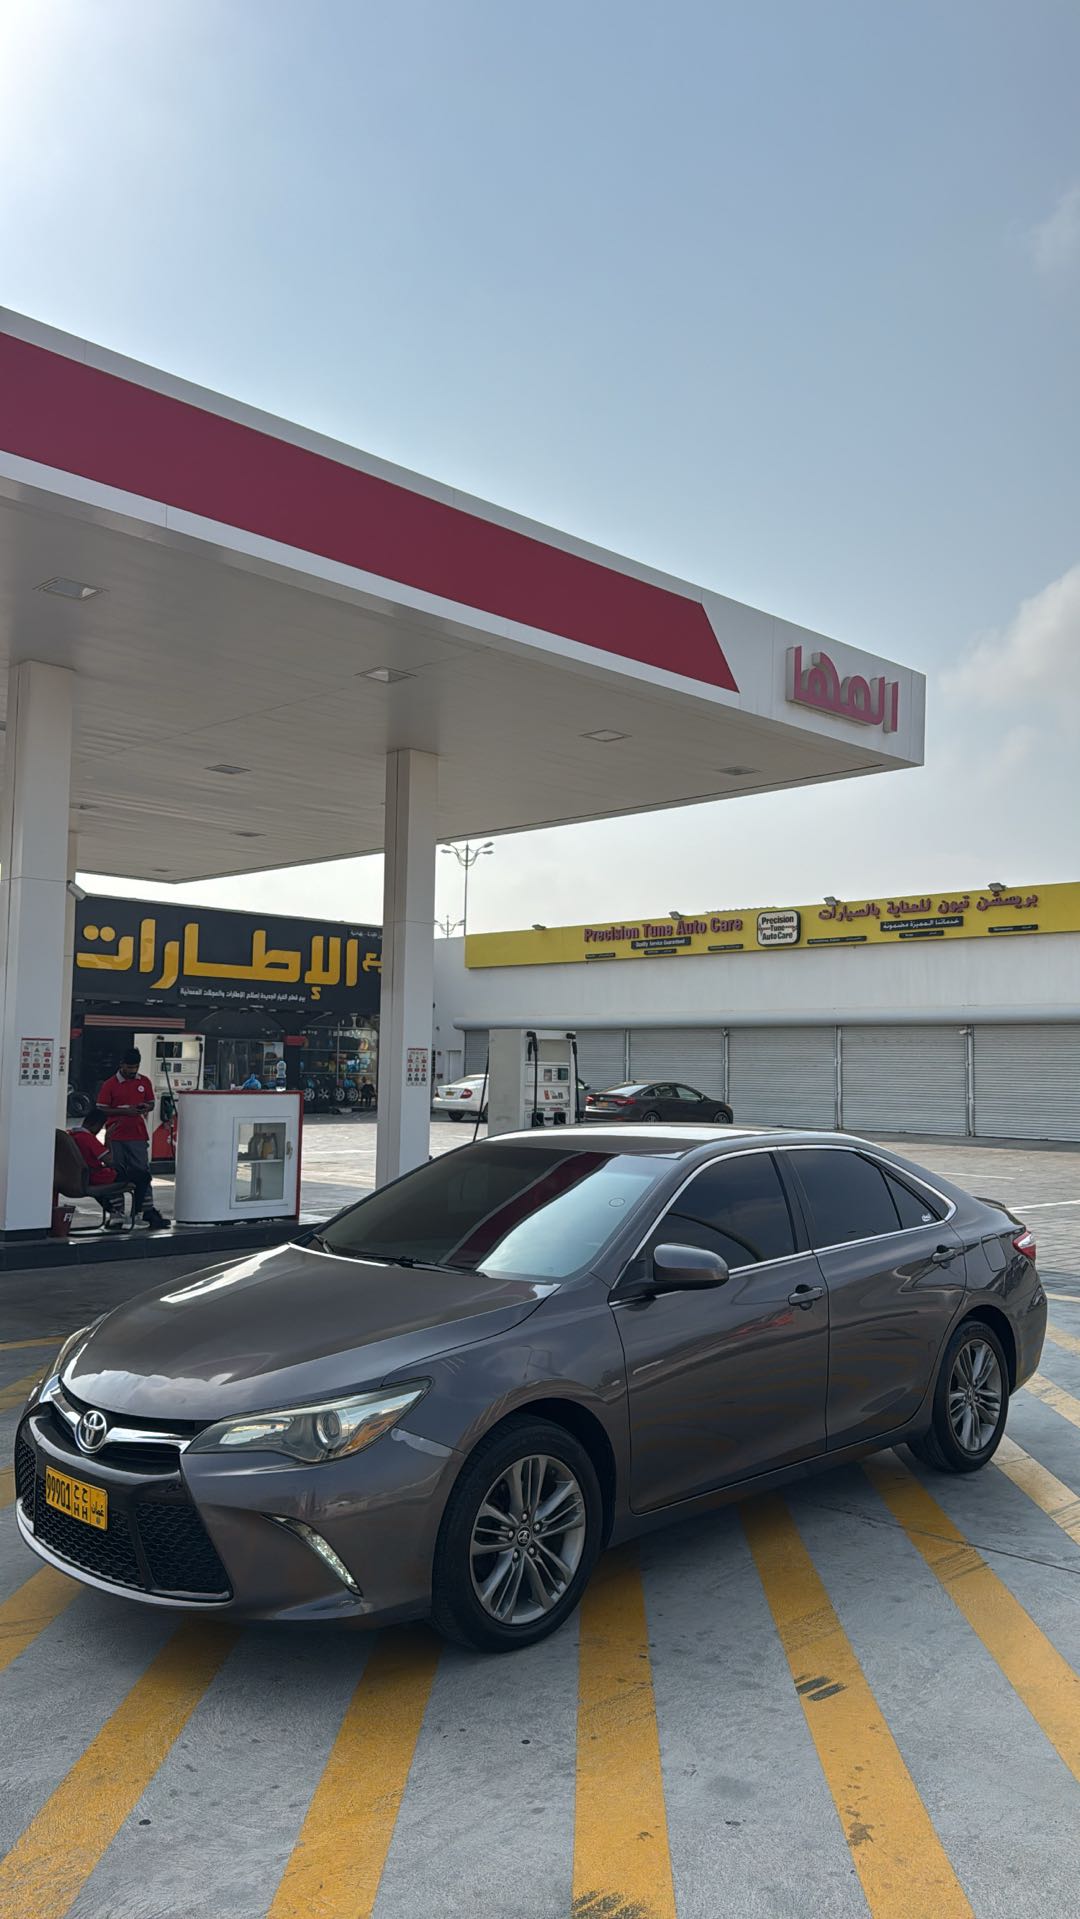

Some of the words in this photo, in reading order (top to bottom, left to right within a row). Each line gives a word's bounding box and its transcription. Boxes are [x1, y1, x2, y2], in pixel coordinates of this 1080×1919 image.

[786, 645, 899, 734] المها
[818, 902, 881, 921] بالسيارات
[887, 898, 932, 917] للعناية
[937, 895, 970, 914] تيون
[761, 915, 794, 925] Precision
[584, 925, 640, 943] Precision
[643, 923, 673, 938] Tune
[676, 919, 707, 936] Auto
[710, 917, 744, 933] Care
[762, 932, 777, 940] Auto
[778, 931, 793, 939] Care
[76, 918, 359, 1000] الإطارات
[47, 1473, 71, 1511] 99901
